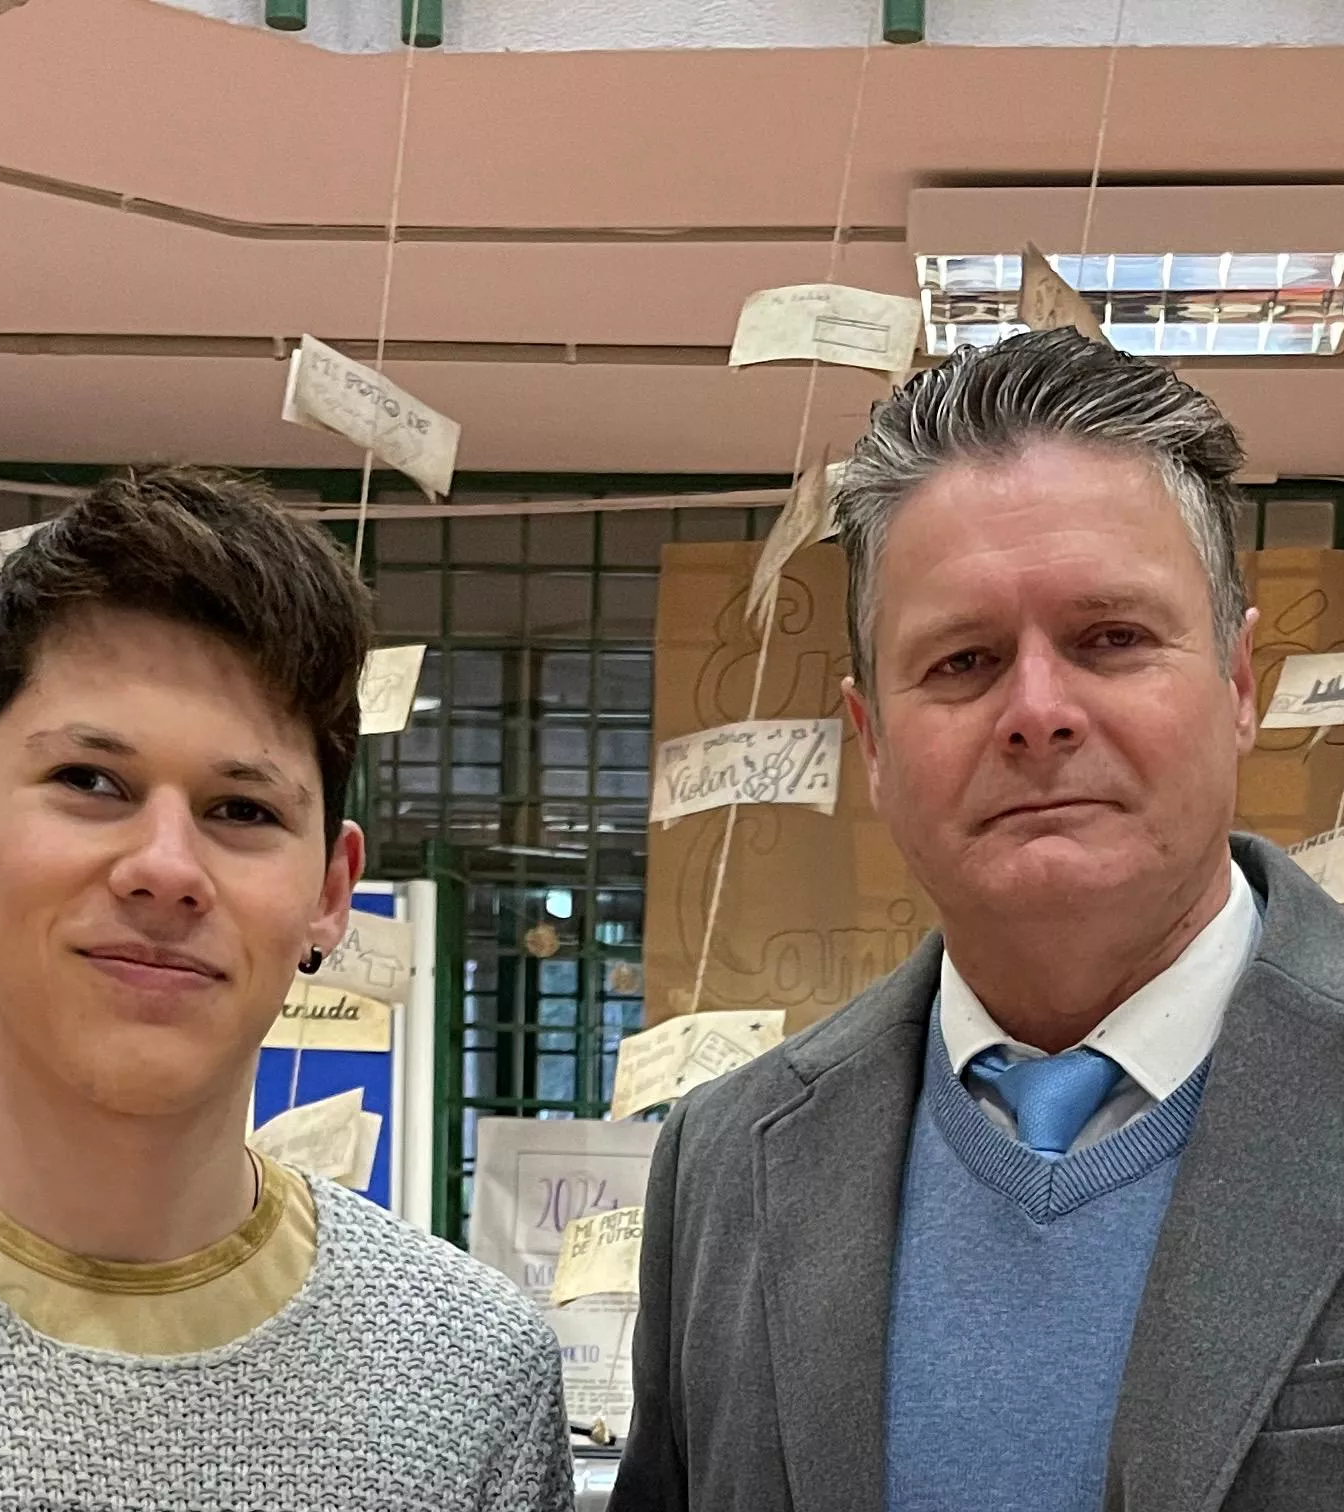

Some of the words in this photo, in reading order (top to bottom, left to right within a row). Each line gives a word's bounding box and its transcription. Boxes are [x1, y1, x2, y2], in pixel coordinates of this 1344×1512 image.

[282, 993, 361, 1021] rnuda
[600, 1208, 640, 1231] PRIME
[572, 1243, 591, 1259] DE
[598, 1226, 642, 1247] FUTBO
